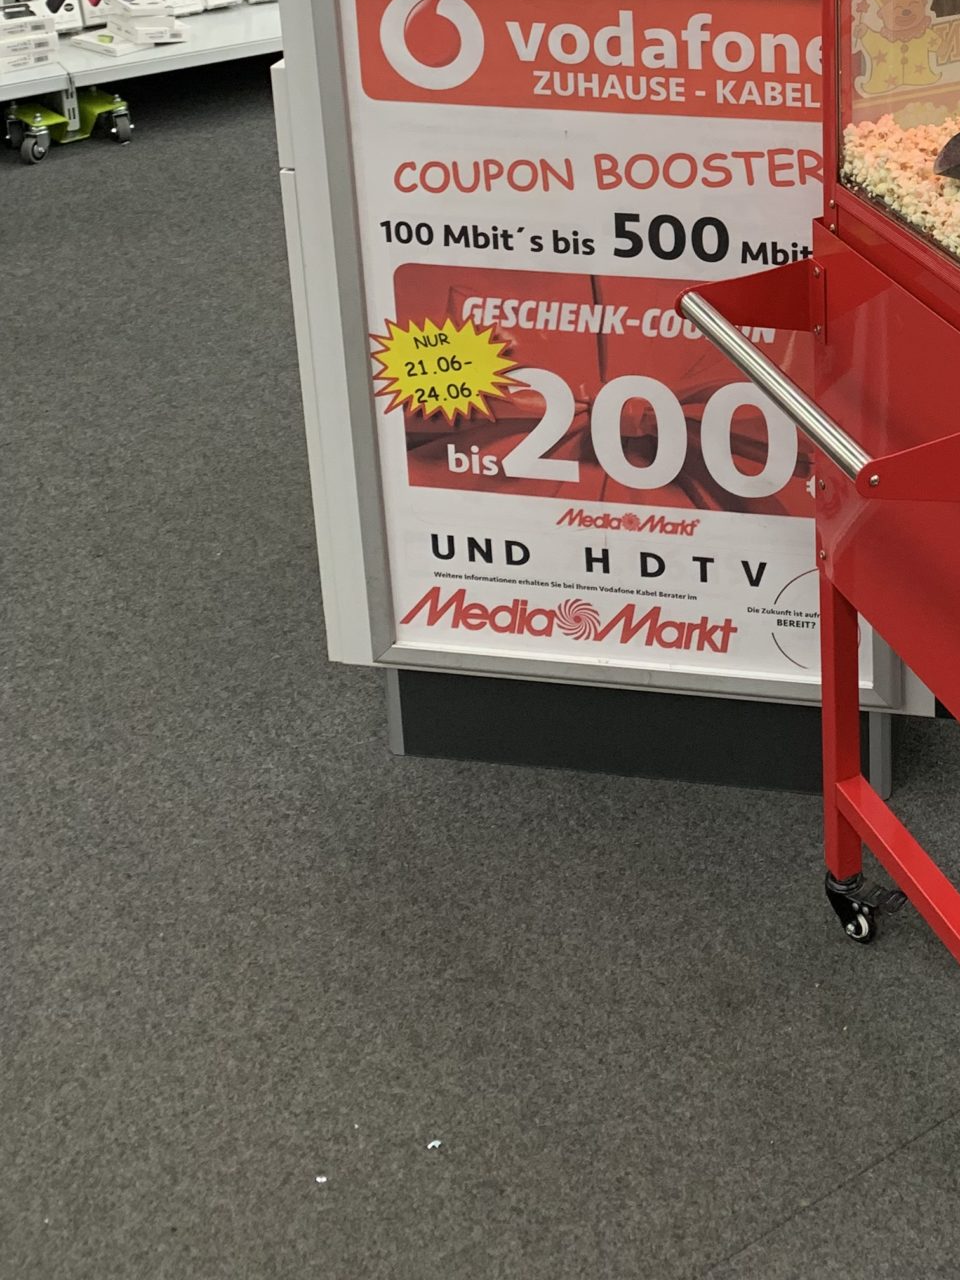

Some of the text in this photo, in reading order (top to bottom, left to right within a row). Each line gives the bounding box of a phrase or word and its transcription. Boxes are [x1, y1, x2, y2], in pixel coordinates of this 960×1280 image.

[533, 70, 685, 102] ZUHAUSE
[716, 79, 820, 108] KABEL
[394, 148, 823, 194] COUPON BOOSTER
[380, 220, 434, 245] 100
[552, 230, 595, 255] bis
[613, 212, 729, 263] 500
[413, 333, 450, 349] NUR
[447, 367, 799, 499] bis 200
[556, 508, 700, 536] Media Markt
[431, 533, 530, 566] UND
[434, 571, 463, 580] Weitere
[464, 574, 517, 584] Informationen
[518, 578, 550, 587] erhalten
[576, 583, 598, 592] Ihrem
[599, 585, 635, 595] Vodafone
[636, 588, 657, 597] Kabel
[658, 591, 686, 600] Berater
[400, 586, 738, 653] Media Markt
[761, 608, 792, 617] Zukunft
[776, 619, 816, 629] BEREIT?
